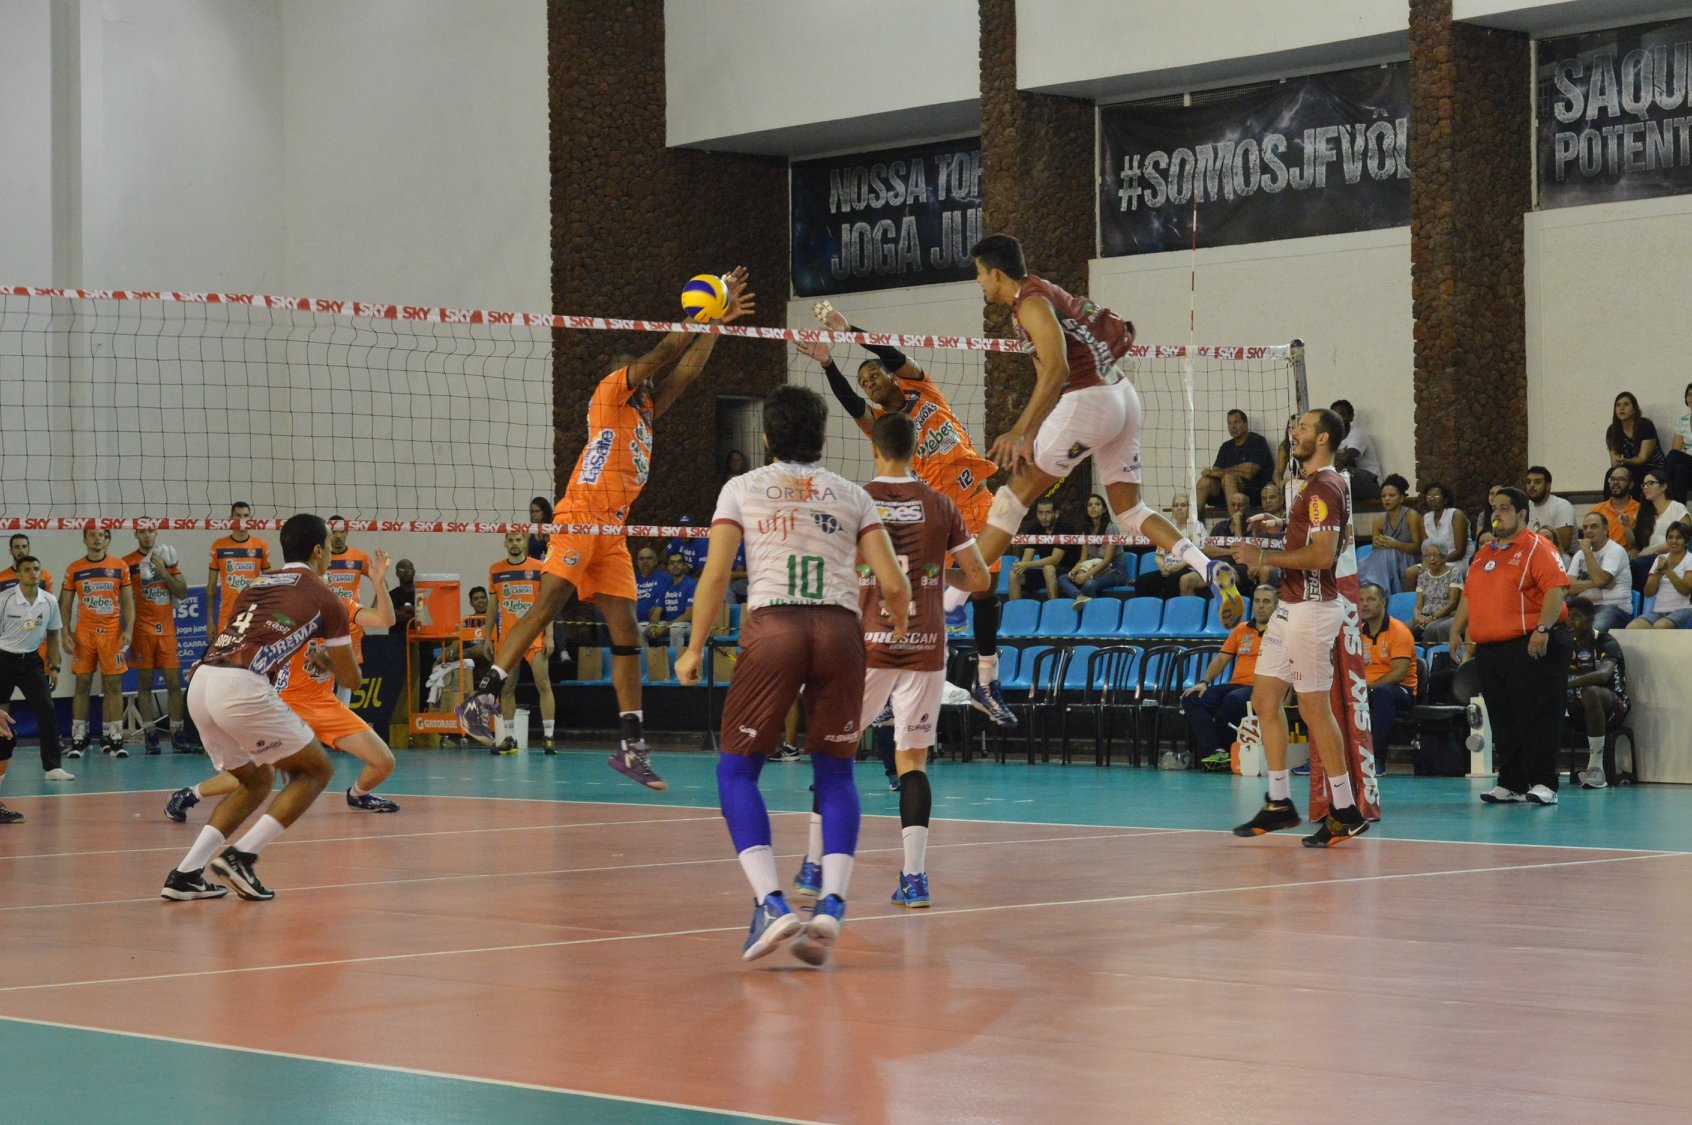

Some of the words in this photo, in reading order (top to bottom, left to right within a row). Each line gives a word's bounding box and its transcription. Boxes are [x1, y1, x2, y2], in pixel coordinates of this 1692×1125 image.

[1554, 41, 1692, 124] SAQU
[1555, 115, 1692, 182] POTENT
[829, 157, 927, 214] NOSSA
[831, 215, 923, 280] JOGA
[315, 299, 345, 312] SKY
[359, 303, 388, 318] SKY
[402, 306, 431, 320] SKY
[444, 309, 474, 323] SKY
[488, 311, 515, 324] SKY
[528, 313, 557, 327] SKY
[569, 316, 595, 328] SKY
[608, 318, 635, 330] SKY
[650, 321, 674, 332] SKY
[687, 322, 712, 333] SKY
[724, 325, 750, 336] SKY
[761, 327, 786, 339] SKY
[799, 329, 822, 341] SKY
[833, 331, 858, 343] SKY
[869, 333, 892, 344] SKY
[903, 334, 927, 347] SKY
[938, 337, 960, 348] SKY
[971, 338, 994, 350] SKY
[1129, 345, 1149, 358] SKY
[1218, 346, 1237, 359] SKY
[1246, 347, 1267, 359] SKY
[956, 469, 974, 491] 12
[24, 518, 50, 529] SKY
[62, 518, 88, 529] SKY
[101, 518, 126, 530] SKY
[137, 519, 162, 530] SKY
[174, 519, 199, 530] SKY
[208, 520, 234, 530] SKY
[245, 520, 269, 530] SKY
[349, 521, 372, 531] SKY
[382, 521, 402, 532] SKY
[413, 522, 437, 532] SKY
[447, 522, 469, 533] SKY
[478, 523, 500, 533] SKY
[511, 524, 531, 534] SKY
[541, 524, 563, 534] SKY
[572, 524, 594, 534] SKY
[602, 525, 623, 535] SKY
[633, 526, 651, 536] SKY
[662, 527, 679, 537] SKY
[691, 527, 711, 537] SKY
[1014, 535, 1030, 544] SKY
[1039, 535, 1055, 544] SKY
[1064, 535, 1080, 544] SKY
[1088, 535, 1104, 544] SKY
[1112, 535, 1128, 545] SKY
[1136, 535, 1150, 545] SKY
[758, 508, 800, 541] ufjf
[786, 554, 825, 600] 10
[232, 603, 258, 634] 4
[1349, 669, 1372, 732] SKY
[1359, 745, 1380, 807] SKY
